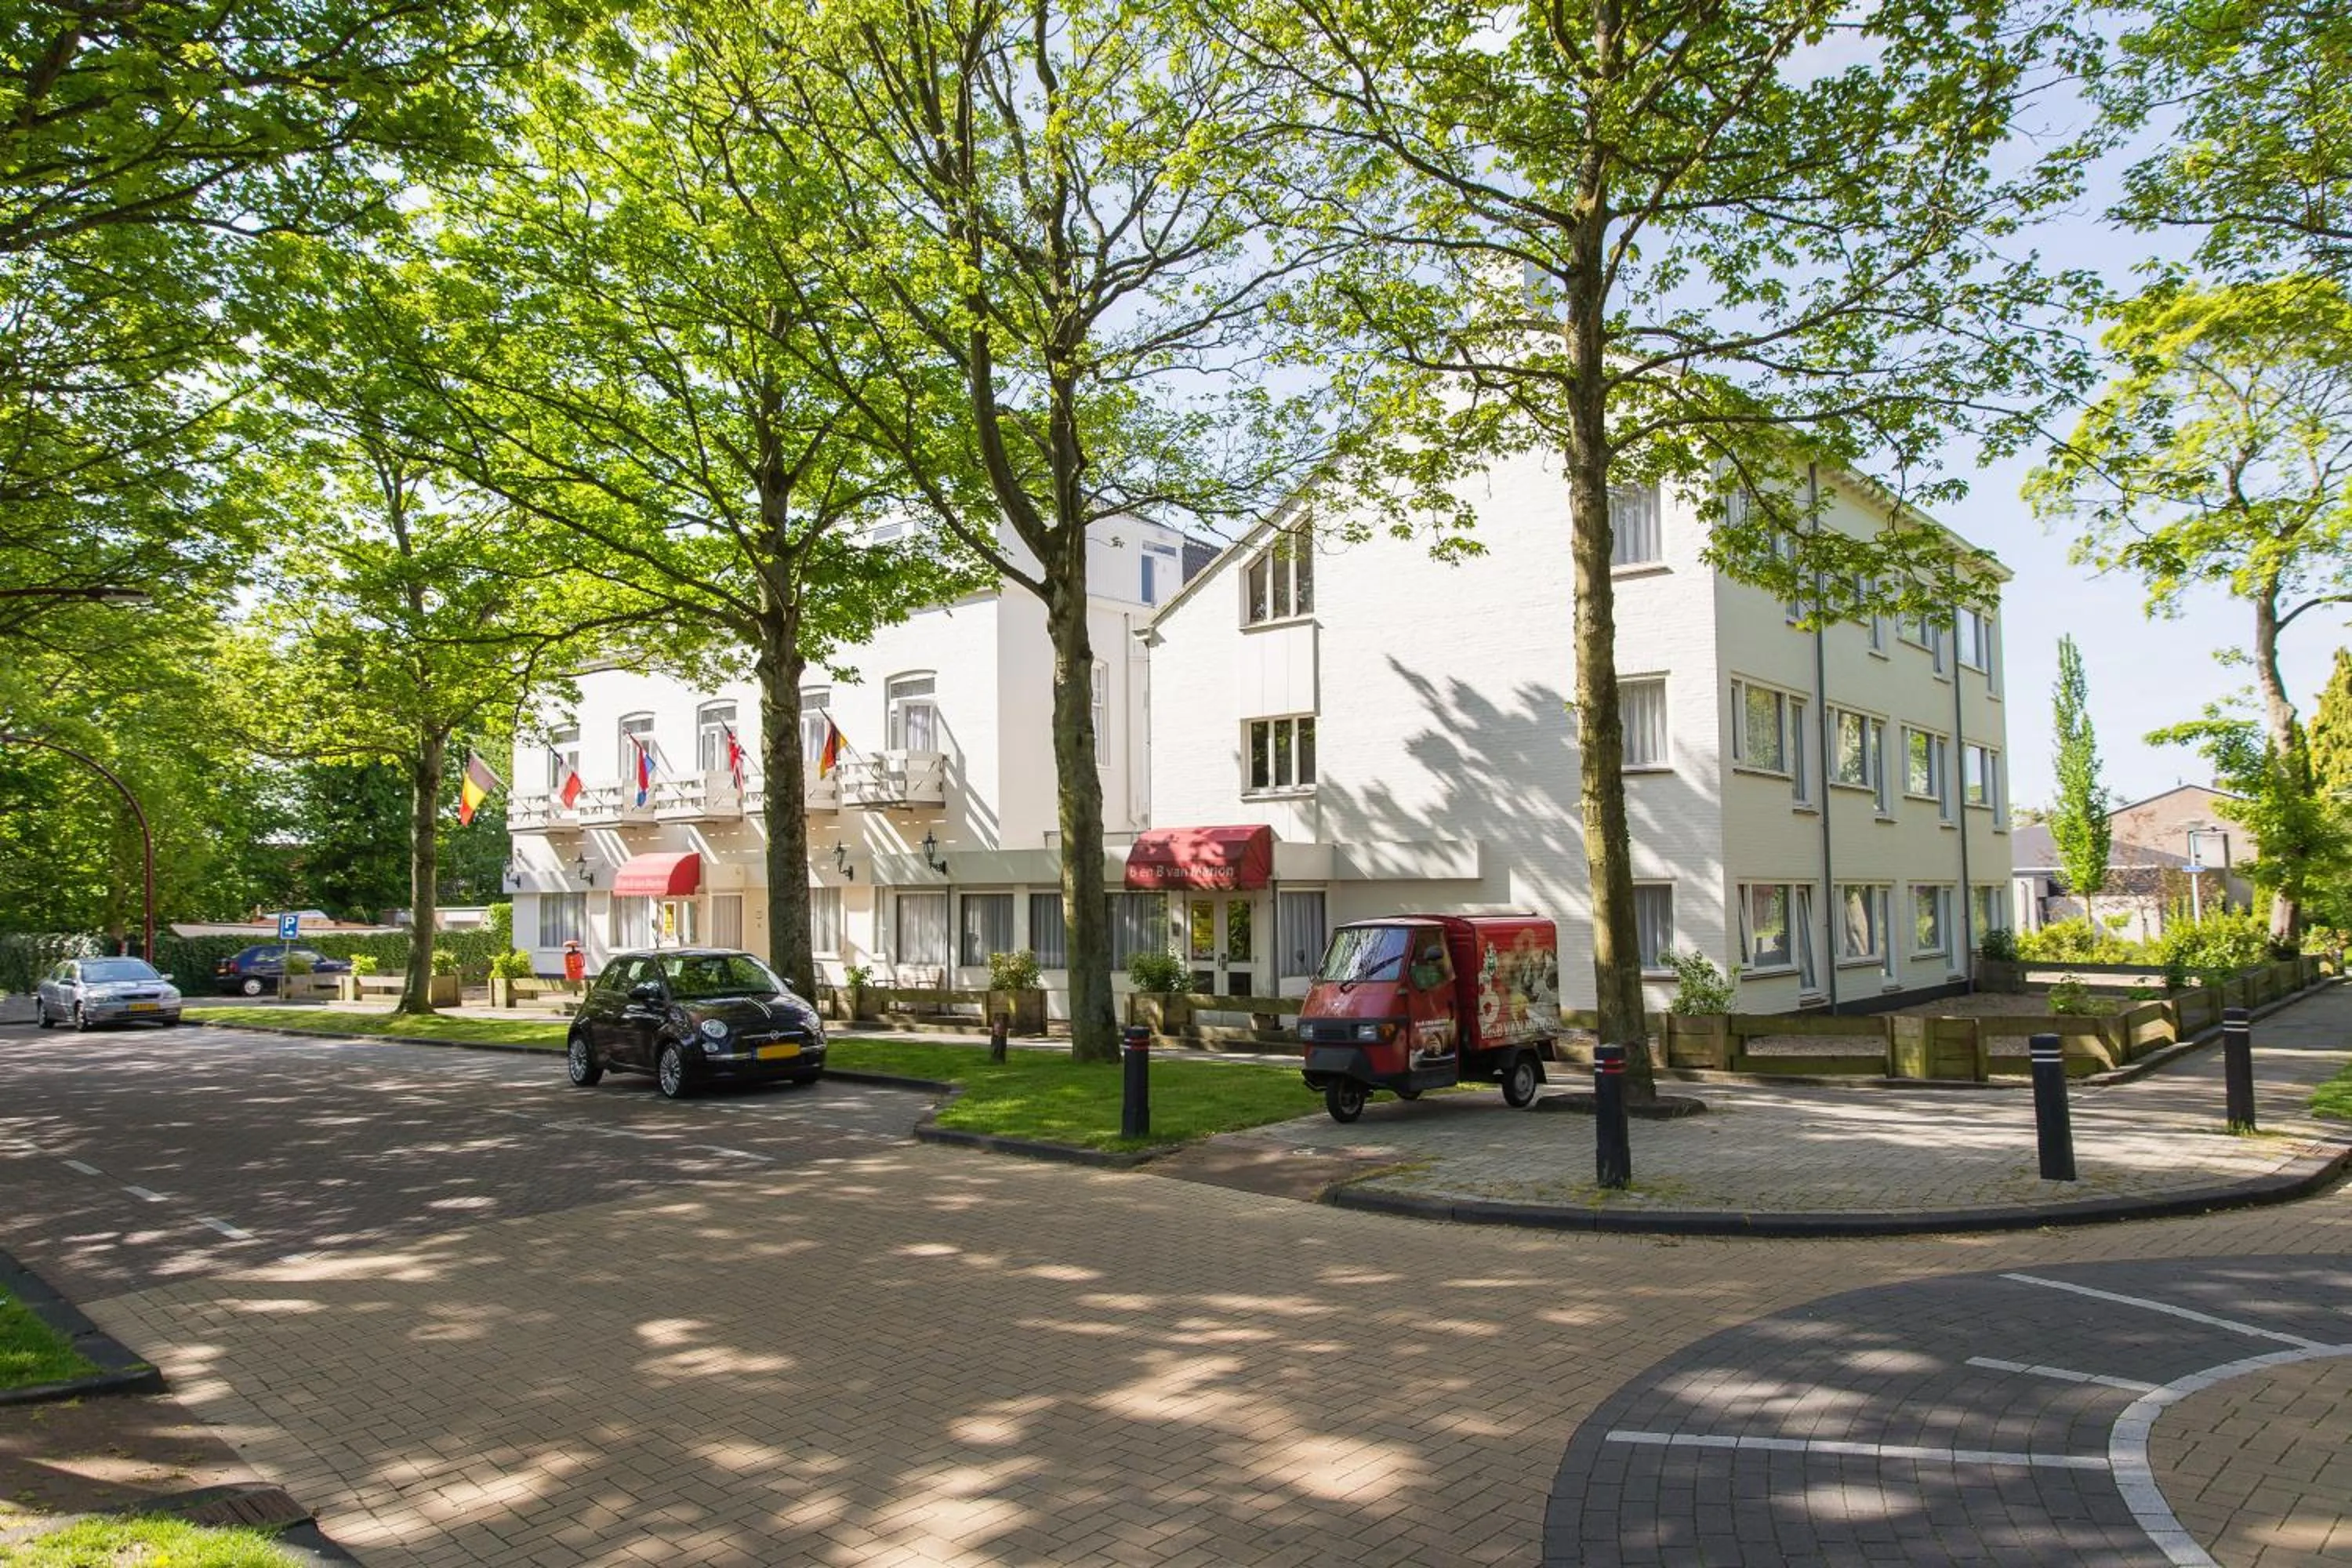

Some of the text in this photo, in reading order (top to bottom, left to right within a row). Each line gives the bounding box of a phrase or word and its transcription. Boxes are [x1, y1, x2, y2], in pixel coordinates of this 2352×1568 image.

[1139, 868, 1153, 877] en
[1156, 866, 1164, 877] B
[1167, 867, 1189, 877] van
[1191, 865, 1233, 877] Marion
[285, 916, 296, 928] P
